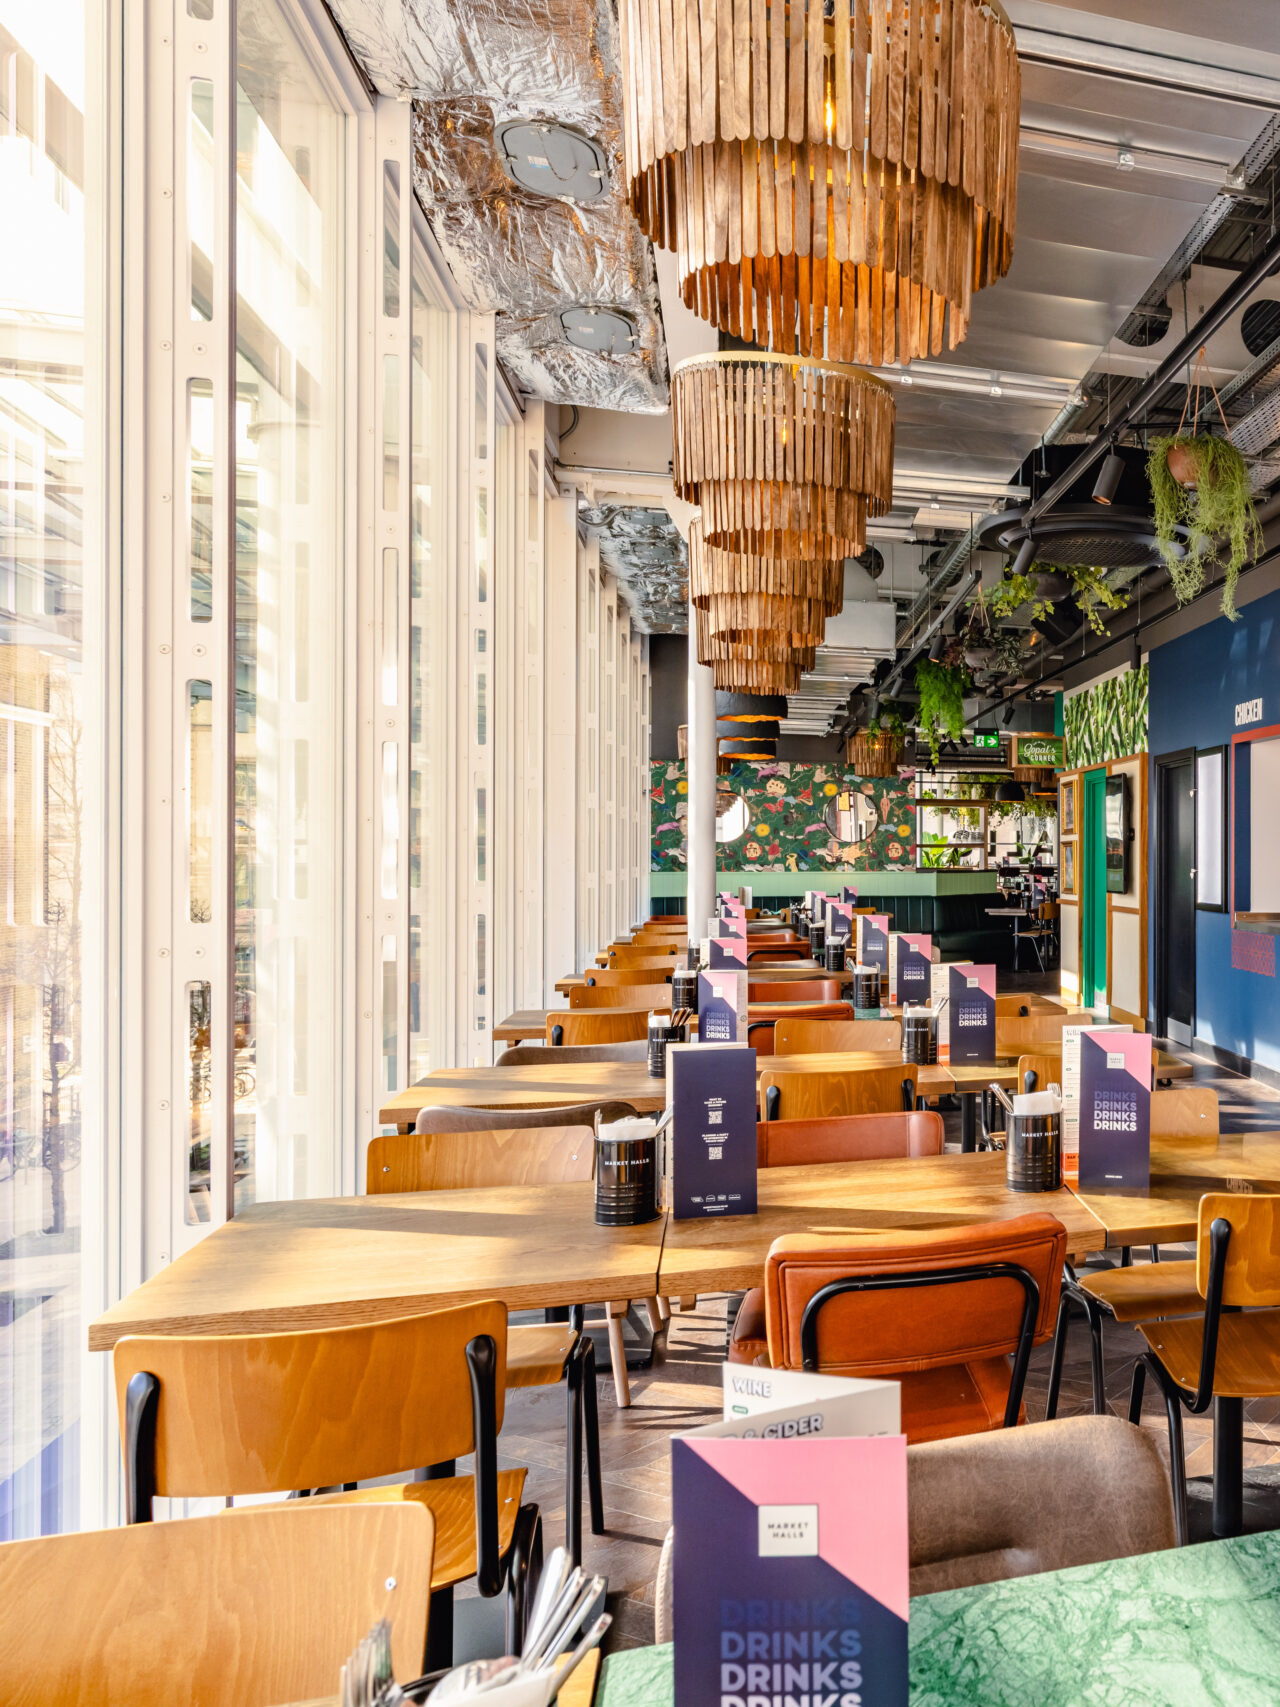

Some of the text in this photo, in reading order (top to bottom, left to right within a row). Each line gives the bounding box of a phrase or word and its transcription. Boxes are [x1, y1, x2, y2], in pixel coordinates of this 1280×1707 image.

[1235, 698, 1263, 727] CHICKEN
[959, 1019, 988, 1027] DRINKS
[706, 1025, 730, 1033] DRINKS
[706, 1031, 730, 1039] DRINKS
[1094, 1091, 1137, 1101] DRINKS
[1094, 1100, 1137, 1111] DRINKS
[1094, 1110, 1137, 1121] DRINKS
[1093, 1120, 1137, 1131] DRINKS
[732, 1376, 772, 1398] WINE
[763, 1413, 824, 1439] CIDER
[768, 1522, 808, 1530] MARKET
[721, 1629, 863, 1660] DRINKS
[721, 1661, 863, 1692] DRINKS
